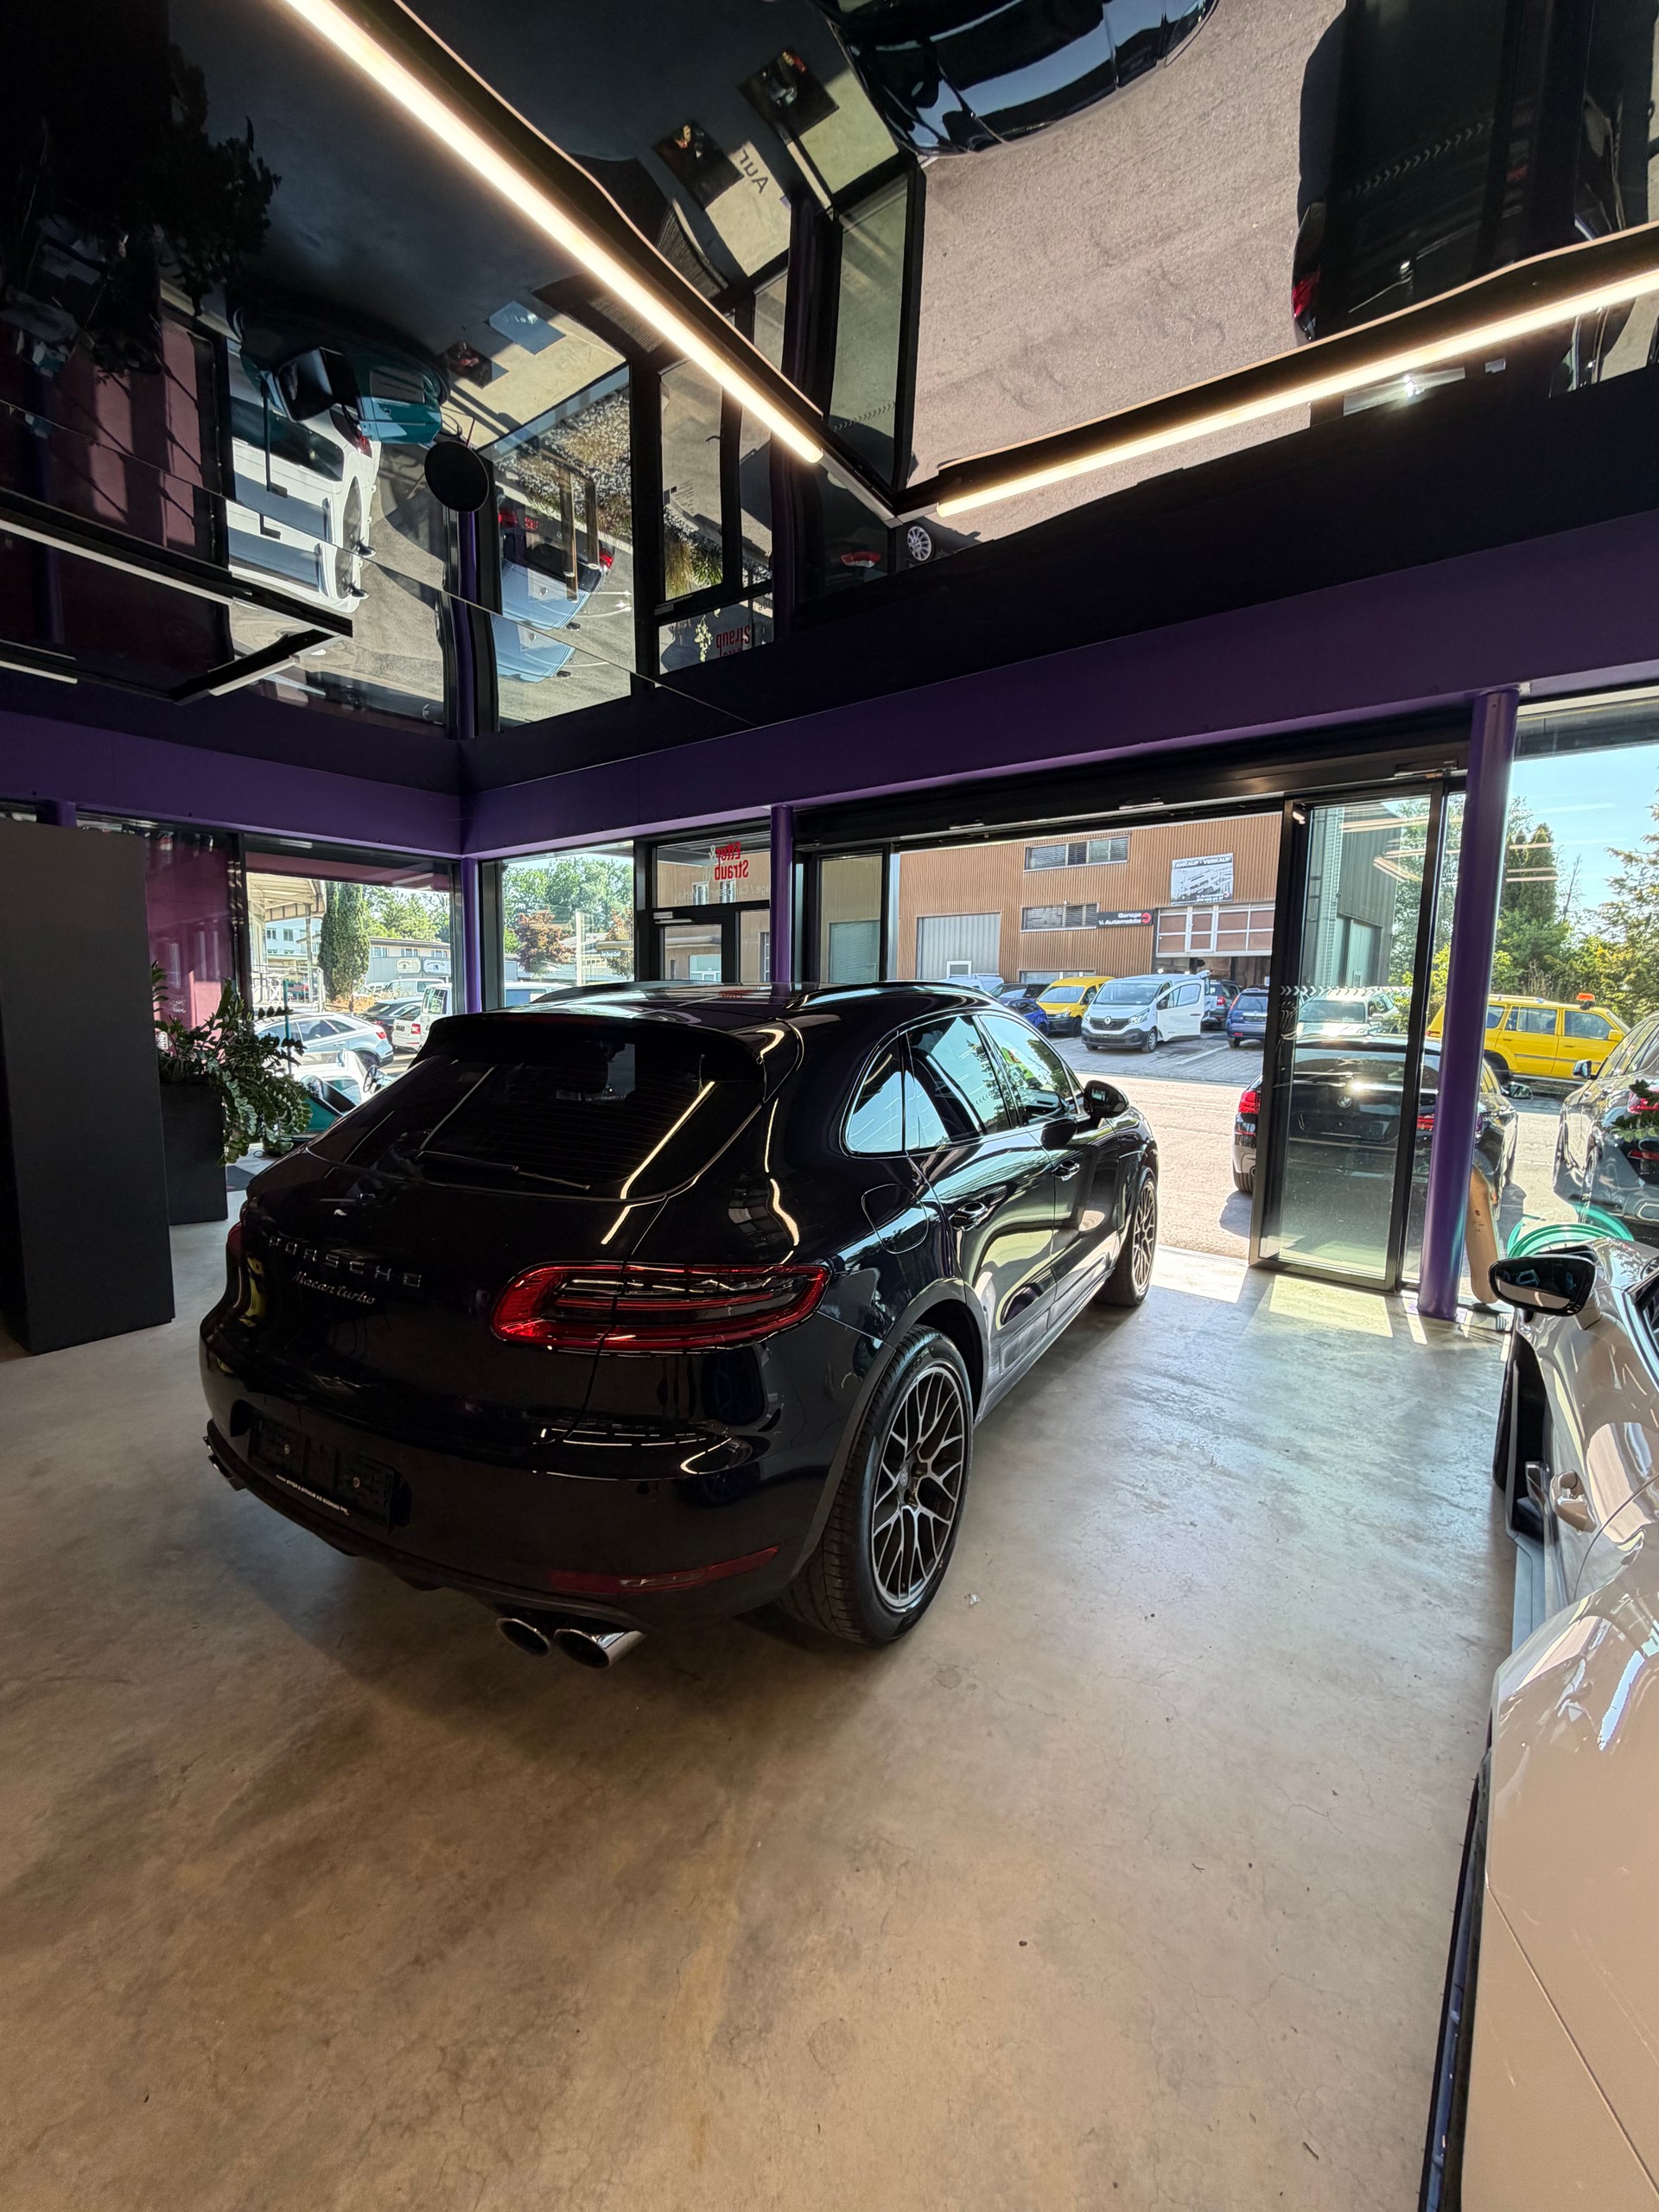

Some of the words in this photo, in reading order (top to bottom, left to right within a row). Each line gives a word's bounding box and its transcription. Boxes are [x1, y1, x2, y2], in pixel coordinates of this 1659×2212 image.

[268, 1235, 422, 1288] PORSCHE
[293, 1270, 335, 1295] Macan
[336, 1285, 377, 1306] Turbo
